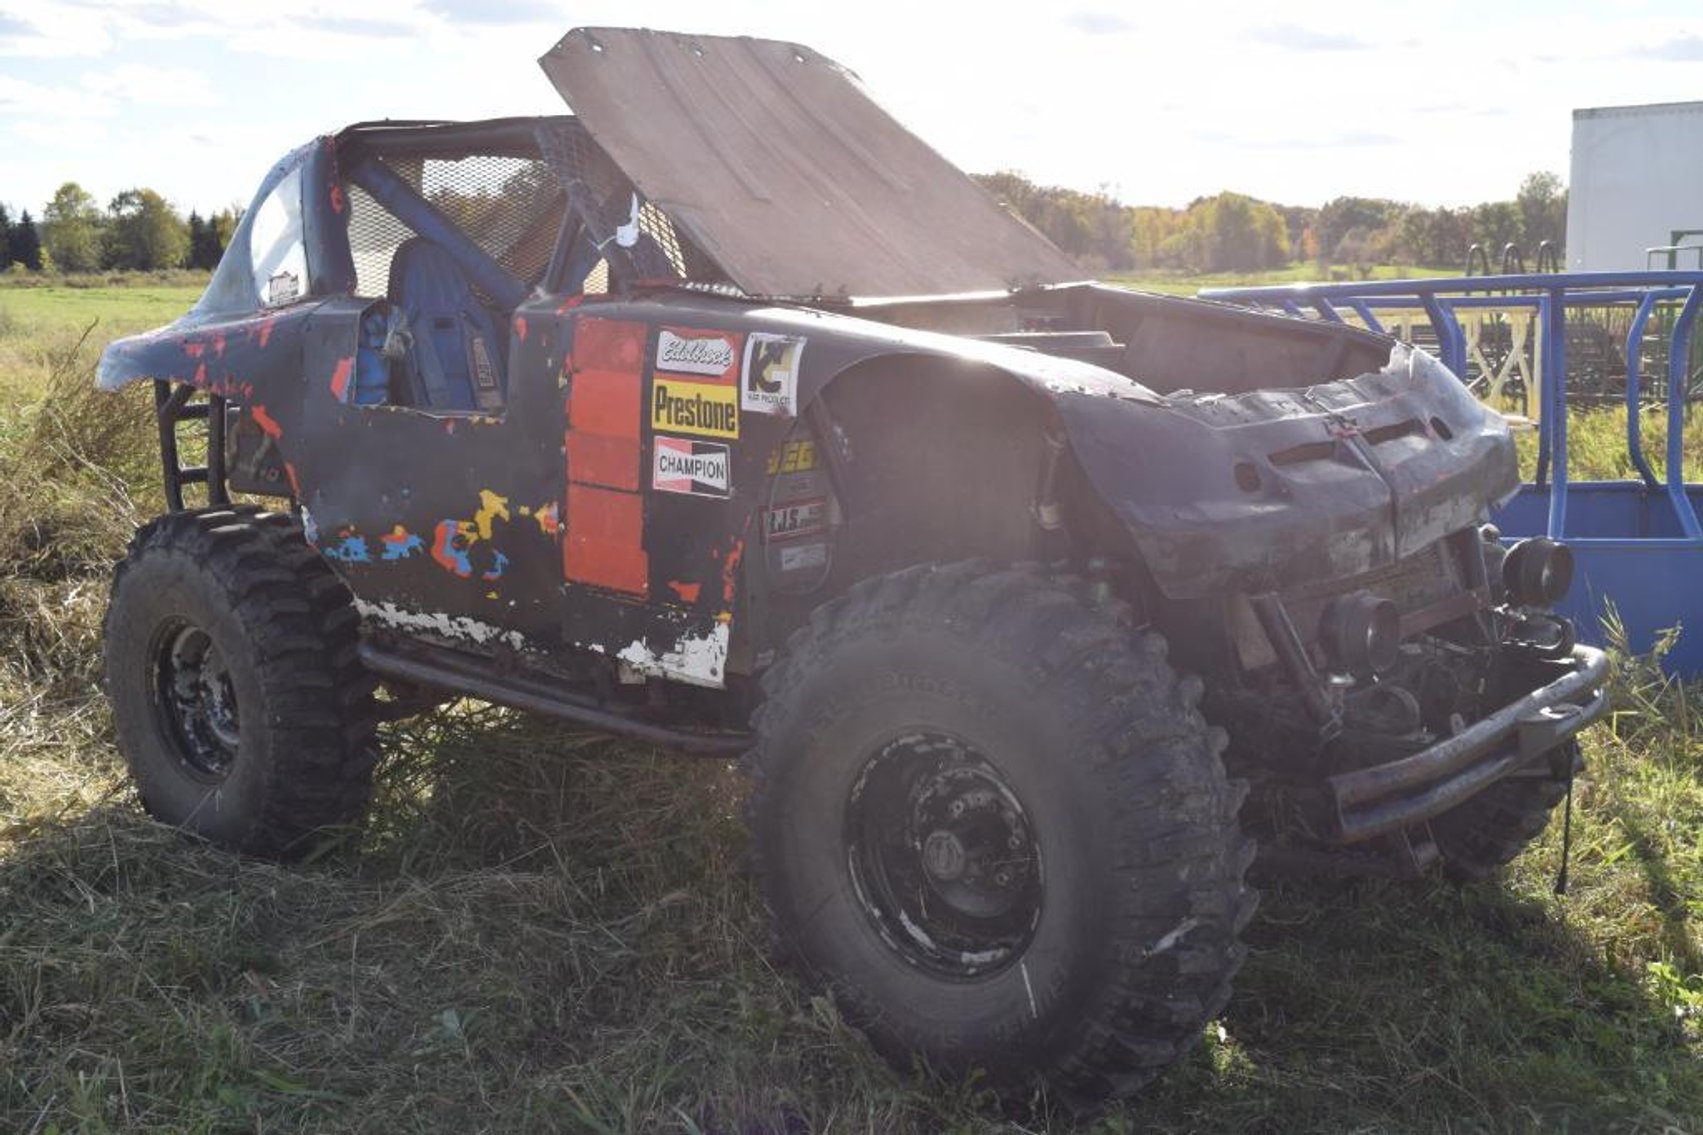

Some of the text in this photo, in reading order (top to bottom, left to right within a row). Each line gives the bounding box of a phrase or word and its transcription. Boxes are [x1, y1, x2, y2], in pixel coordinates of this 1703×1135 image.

[661, 338, 732, 367] Edelbrock
[654, 385, 736, 432] Prestone
[659, 455, 725, 479] CHAMPION
